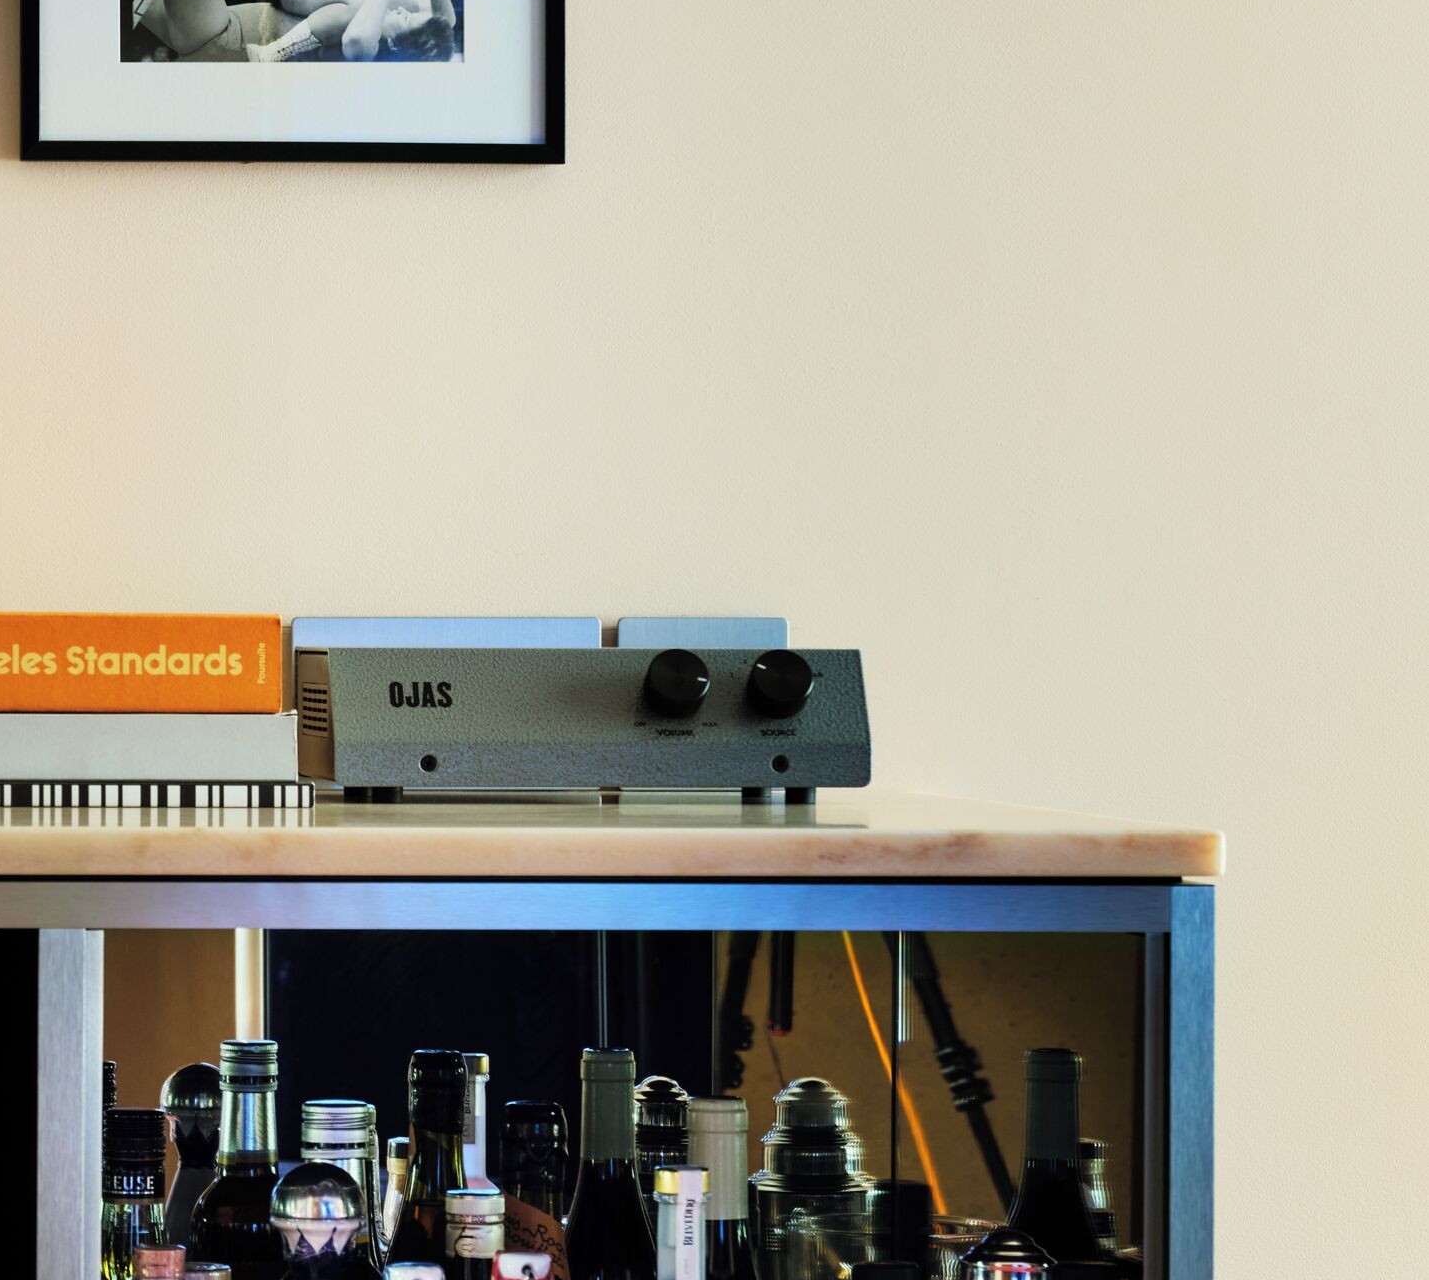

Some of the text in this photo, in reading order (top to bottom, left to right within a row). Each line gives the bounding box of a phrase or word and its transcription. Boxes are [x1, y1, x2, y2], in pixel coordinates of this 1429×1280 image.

[66, 644, 243, 677] Standards
[388, 681, 453, 709] OJAS
[656, 729, 694, 737] VOLUME
[760, 729, 796, 737] SOURCE
